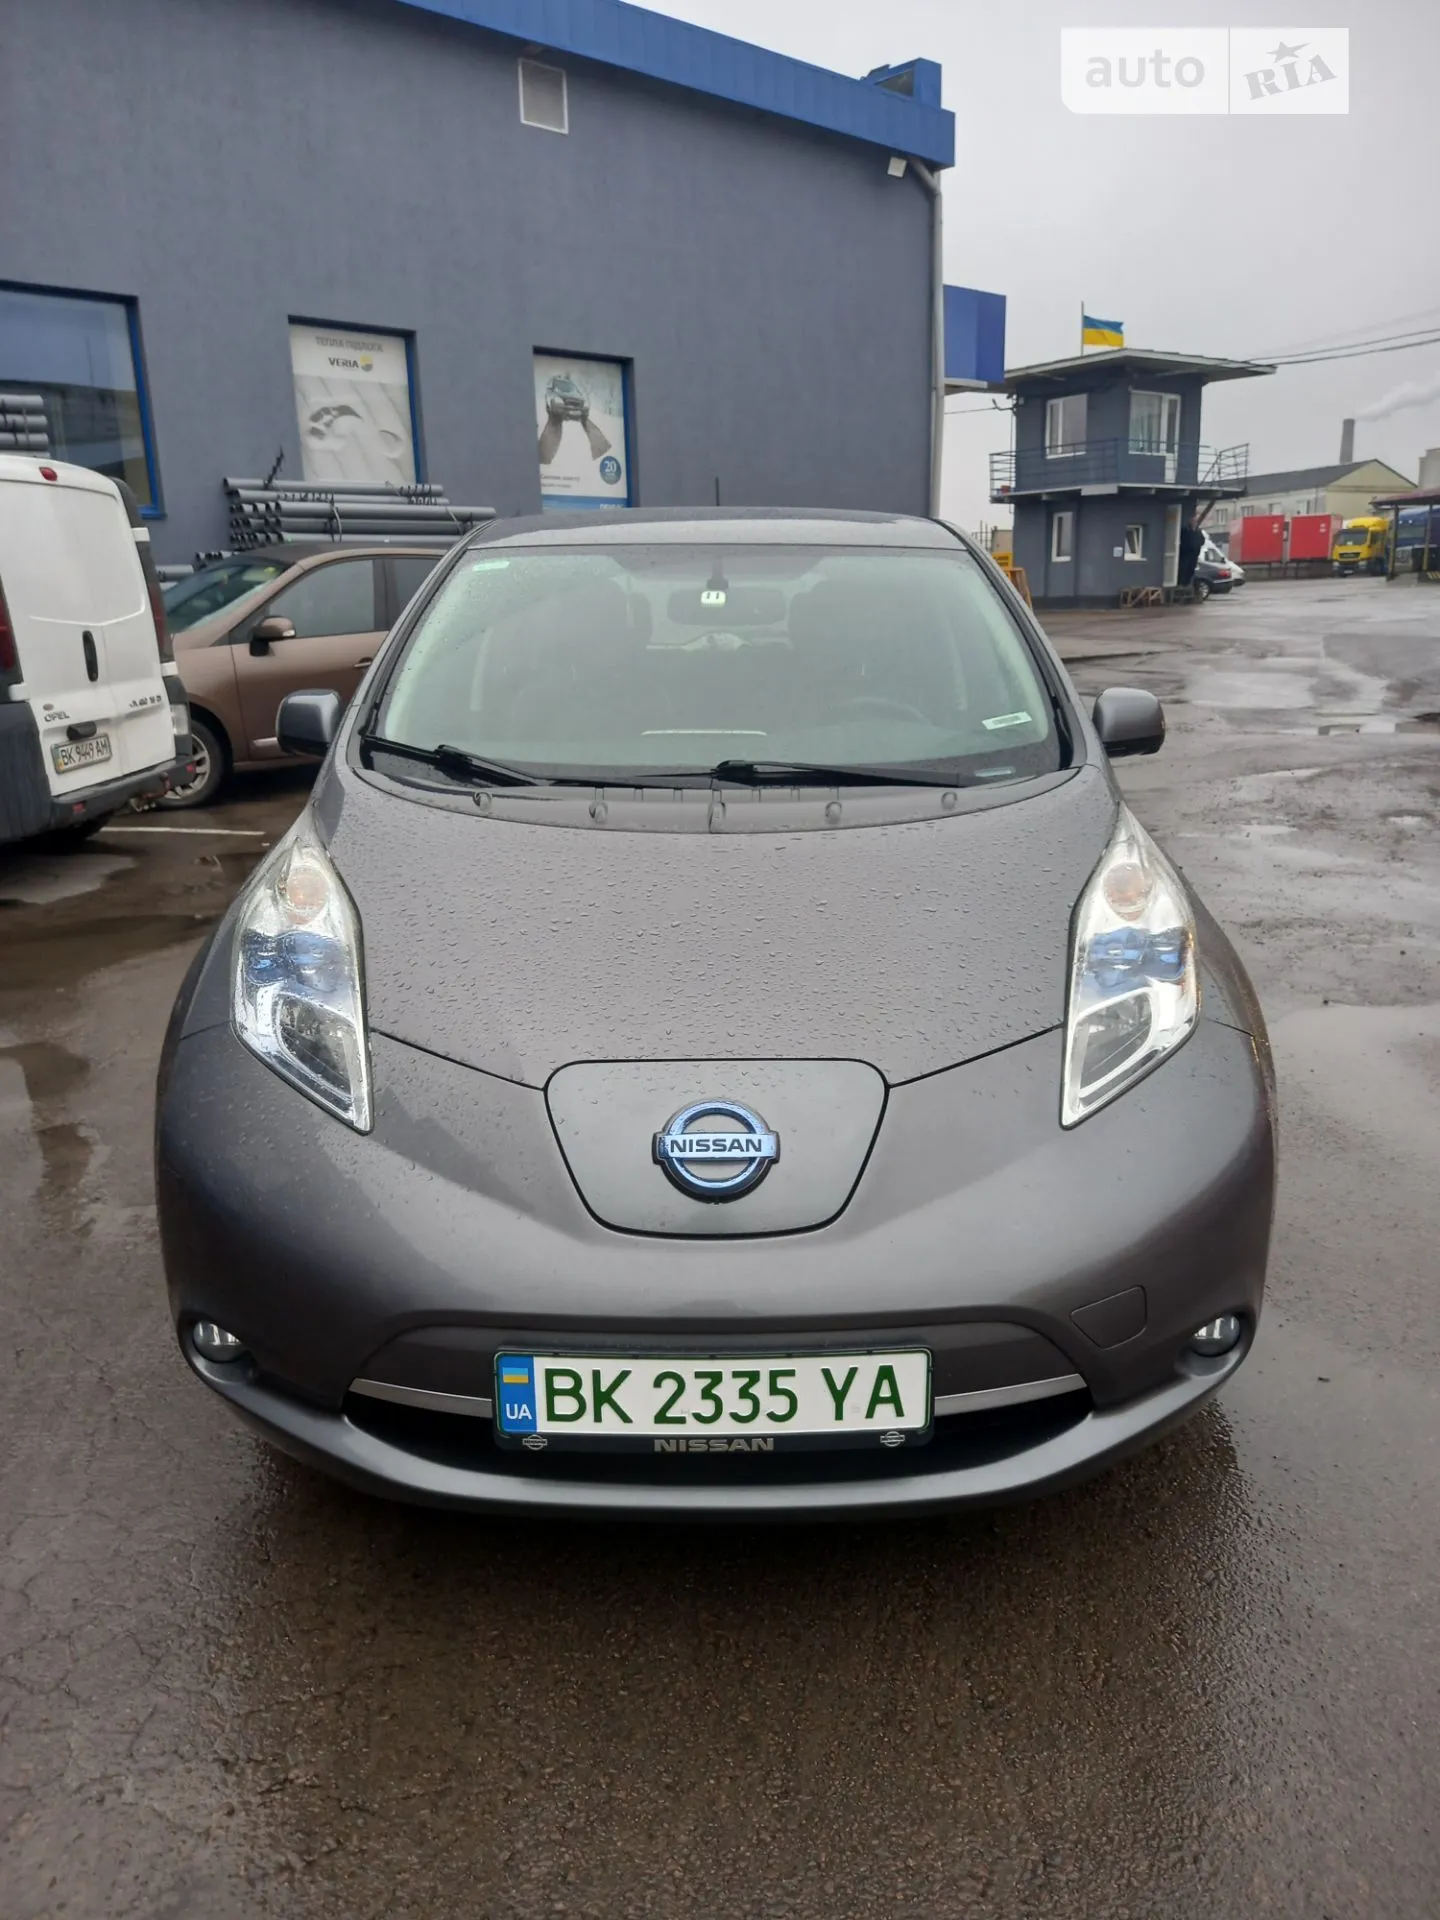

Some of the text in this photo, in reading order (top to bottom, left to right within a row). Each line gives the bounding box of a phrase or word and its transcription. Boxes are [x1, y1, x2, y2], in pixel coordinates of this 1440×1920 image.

[328, 357, 360, 369] VERIA
[603, 460, 617, 473] 20
[43, 711, 70, 722] OPEL
[60, 746, 76, 766] BK
[75, 742, 94, 762] 9449
[670, 1138, 762, 1153] NISSAN
[544, 1364, 906, 1426] BK 2335 YA
[505, 1403, 533, 1421] UA
[653, 1437, 775, 1453] NISSAN
